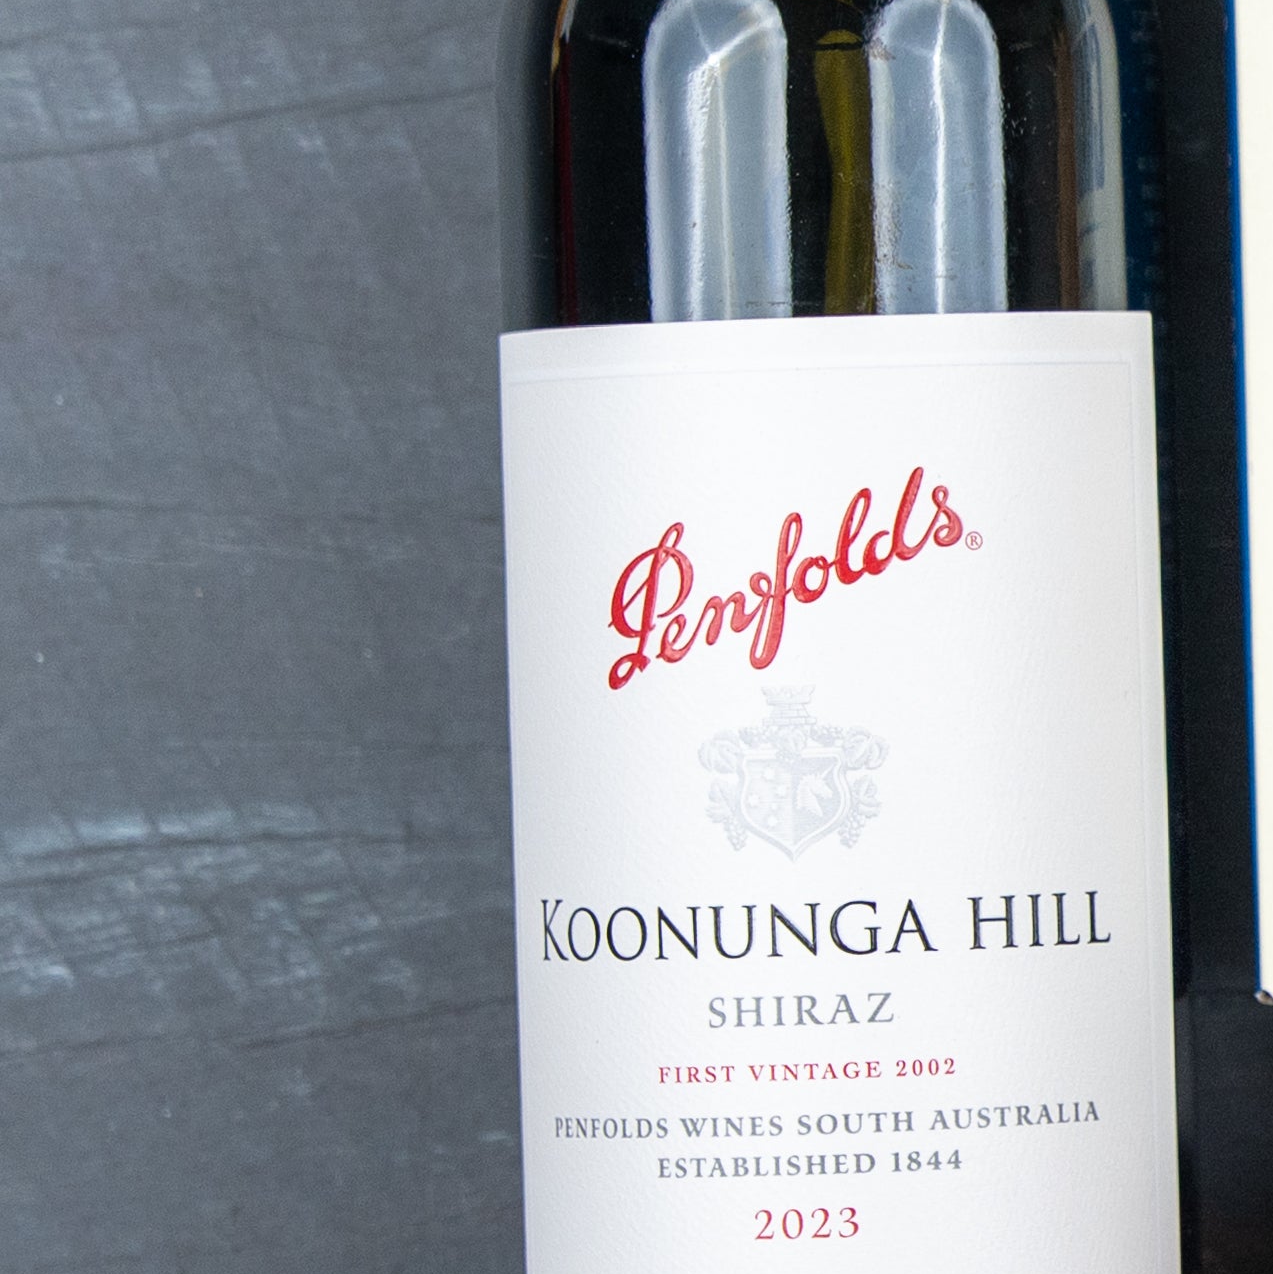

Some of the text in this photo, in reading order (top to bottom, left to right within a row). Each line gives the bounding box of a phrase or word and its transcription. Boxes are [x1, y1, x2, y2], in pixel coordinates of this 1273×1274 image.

[540, 890, 1112, 962] KOONUNGA HILL
[708, 991, 895, 1029] SHIRAZ
[658, 1058, 957, 1085] FIRST VINTAGE 2002
[554, 1100, 1101, 1140] PENFOLDS WINES SOUTH AUSTRALIA
[657, 1149, 963, 1180] ESTABLISHED 1844
[754, 1206, 861, 1241] 2023
